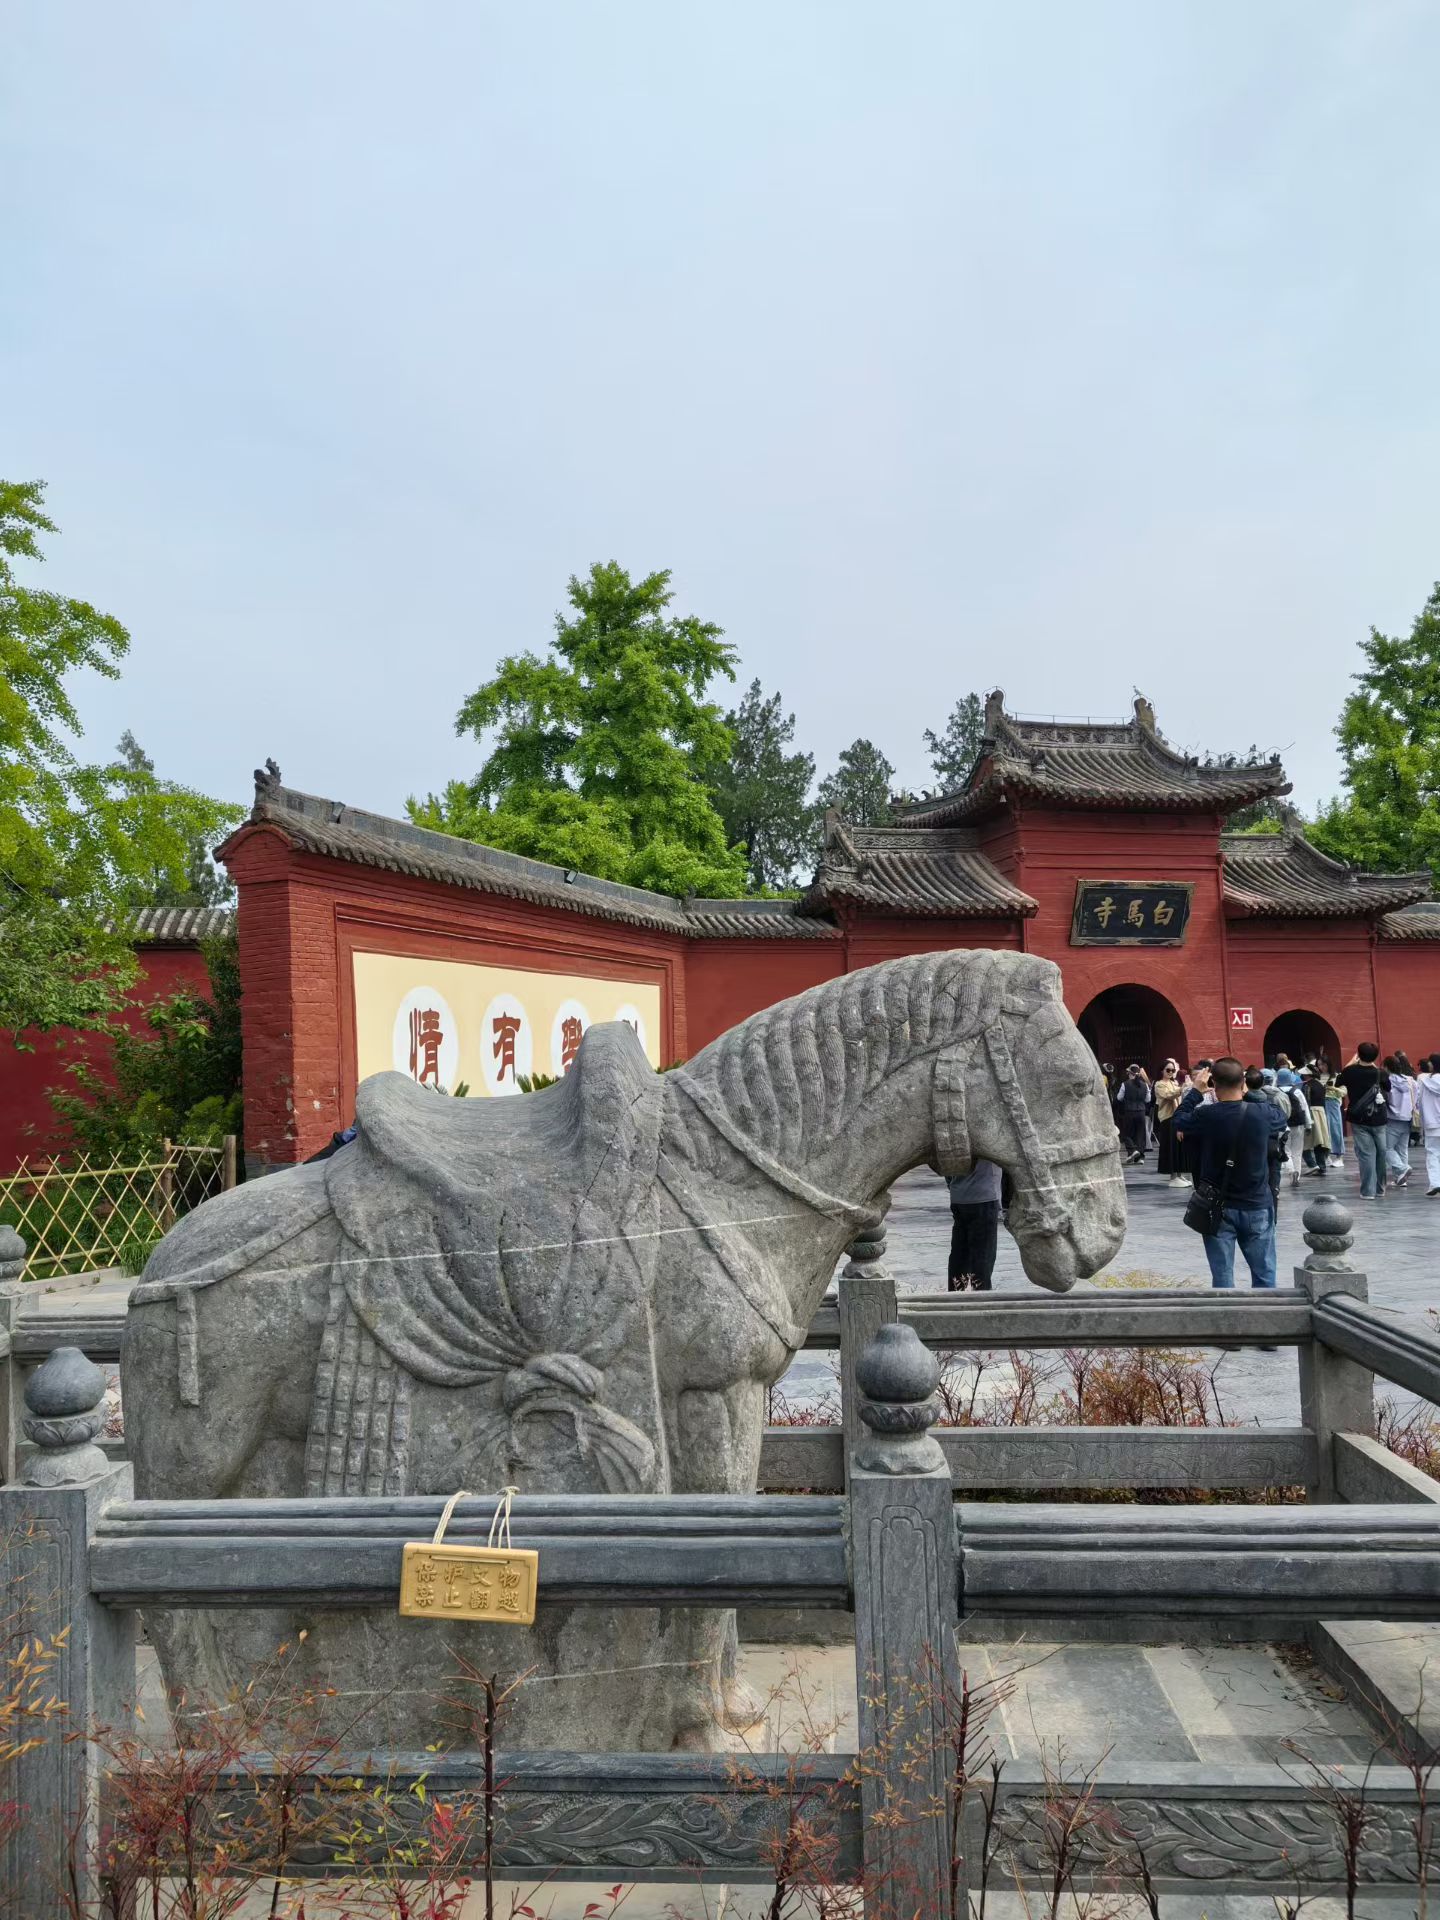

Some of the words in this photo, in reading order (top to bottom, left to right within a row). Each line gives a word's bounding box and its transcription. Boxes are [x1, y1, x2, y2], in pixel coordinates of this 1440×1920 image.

[1093, 896, 1175, 929] 白馬寺
[1232, 1012, 1251, 1025] 入口
[409, 1007, 638, 1085] 樂有情
[415, 1561, 520, 1589] 保护文物
[415, 1584, 520, 1613] 禁止翻越
